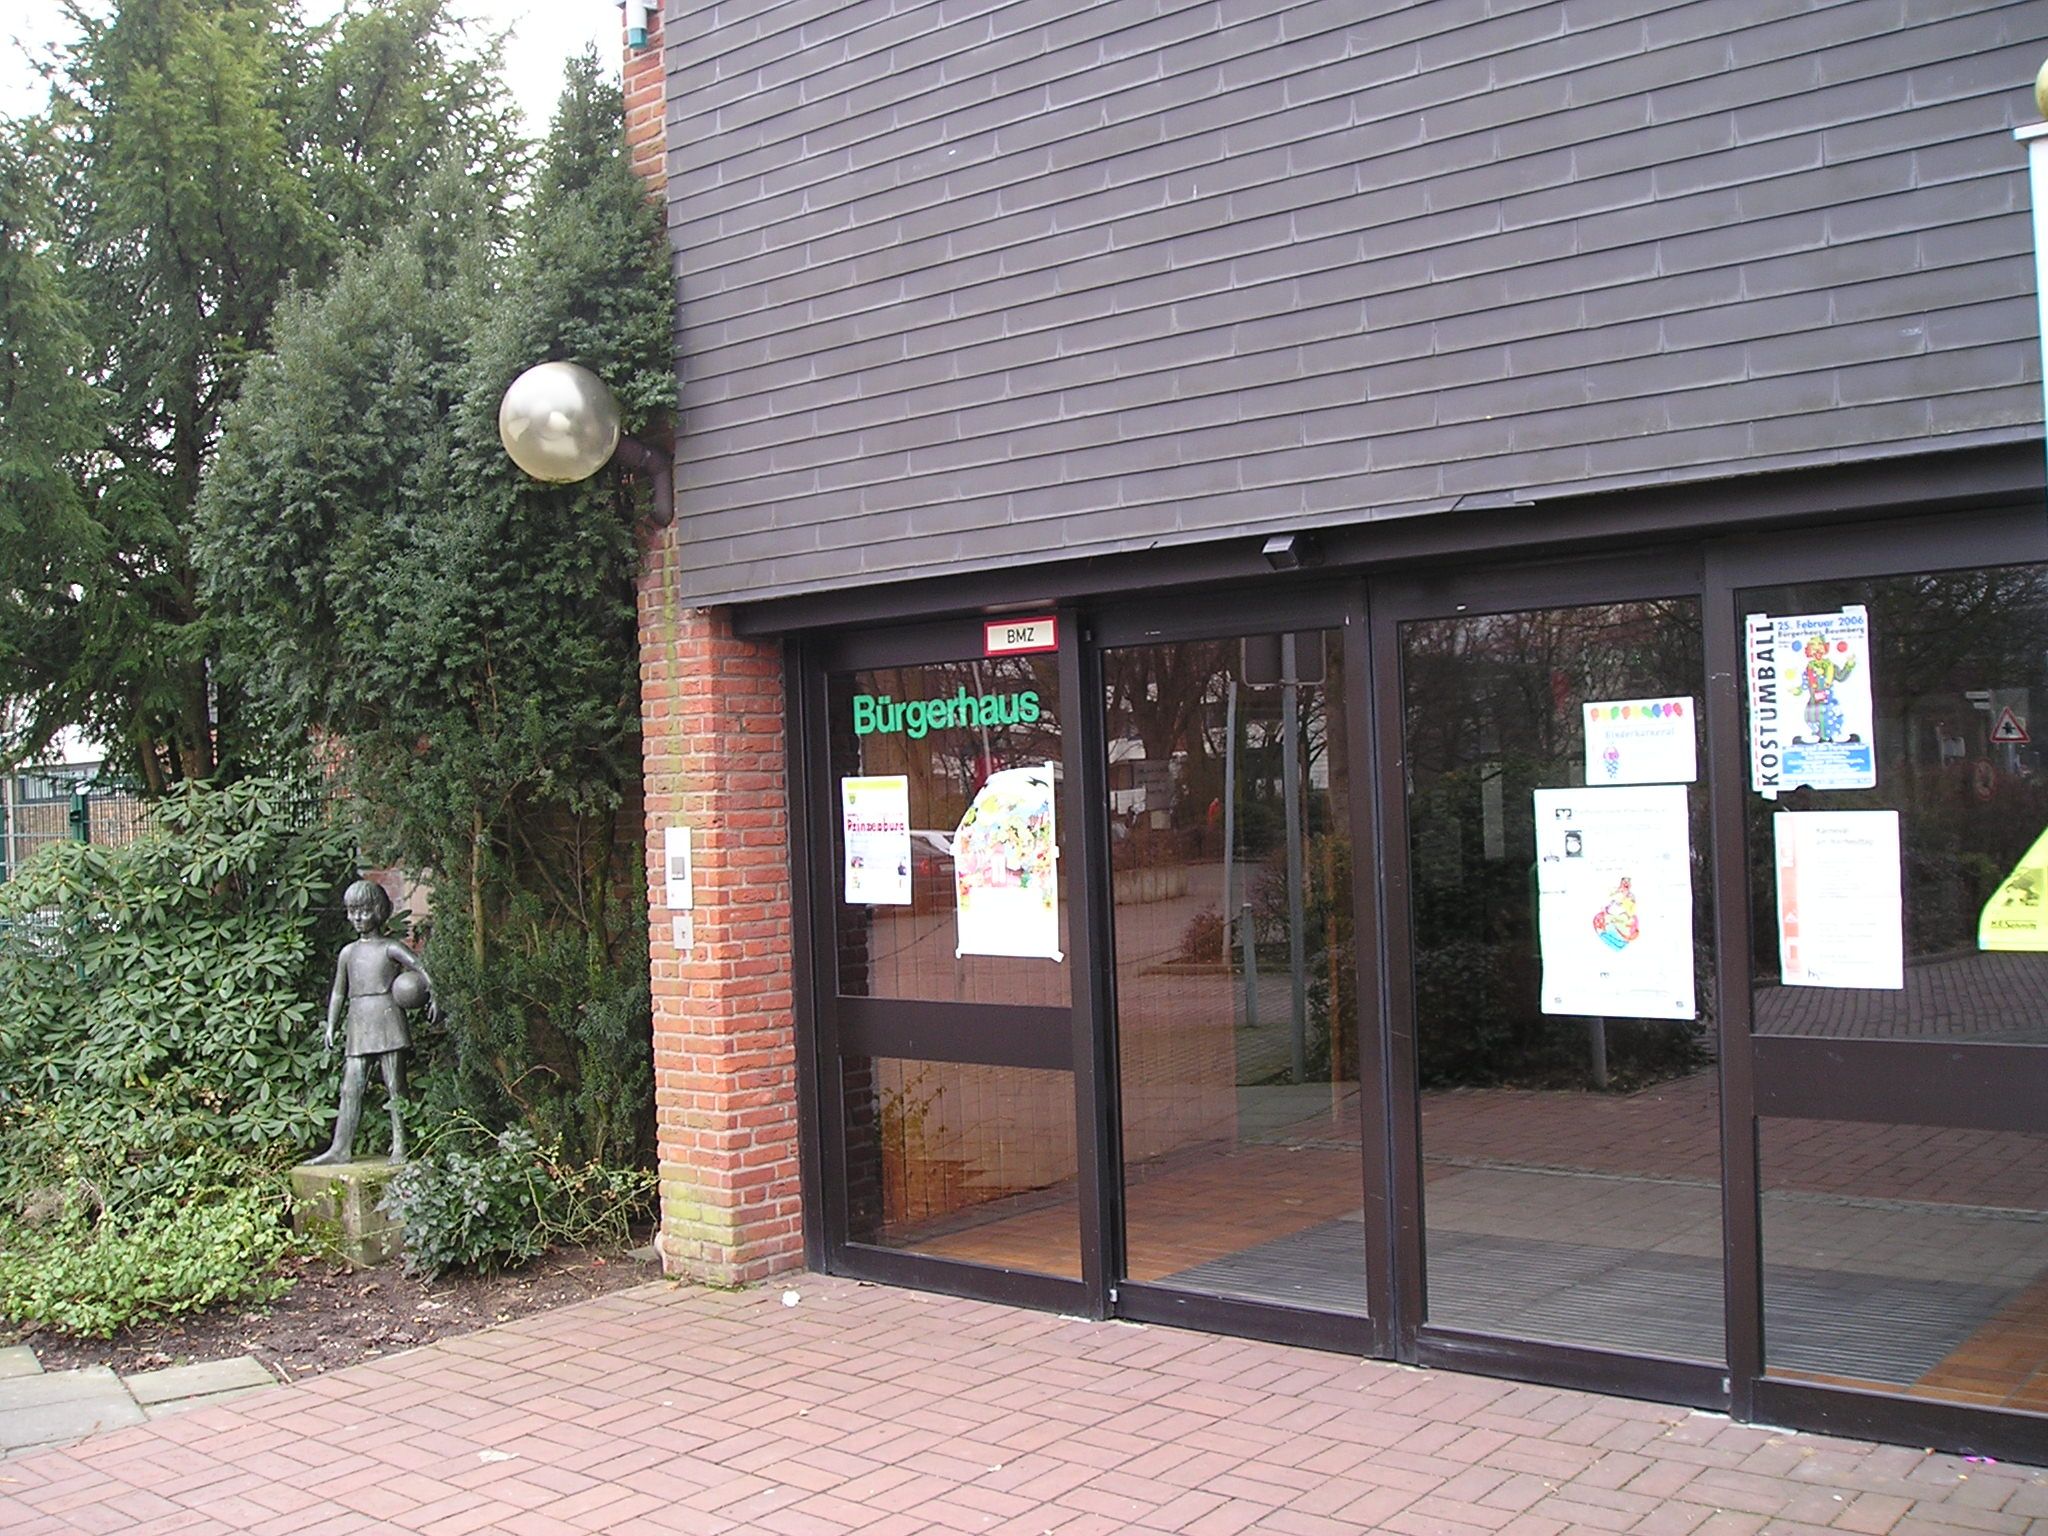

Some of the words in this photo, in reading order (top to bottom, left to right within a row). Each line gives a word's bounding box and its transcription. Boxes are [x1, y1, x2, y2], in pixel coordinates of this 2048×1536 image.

[1007, 627, 1034, 644] BMZ
[1777, 620, 1793, 631] 25.
[1796, 618, 1834, 629] Februar
[1838, 615, 1864, 627] 2006
[852, 686, 1040, 739] Bürgerhaus
[1755, 622, 1779, 786] KOSTÜMBALL
